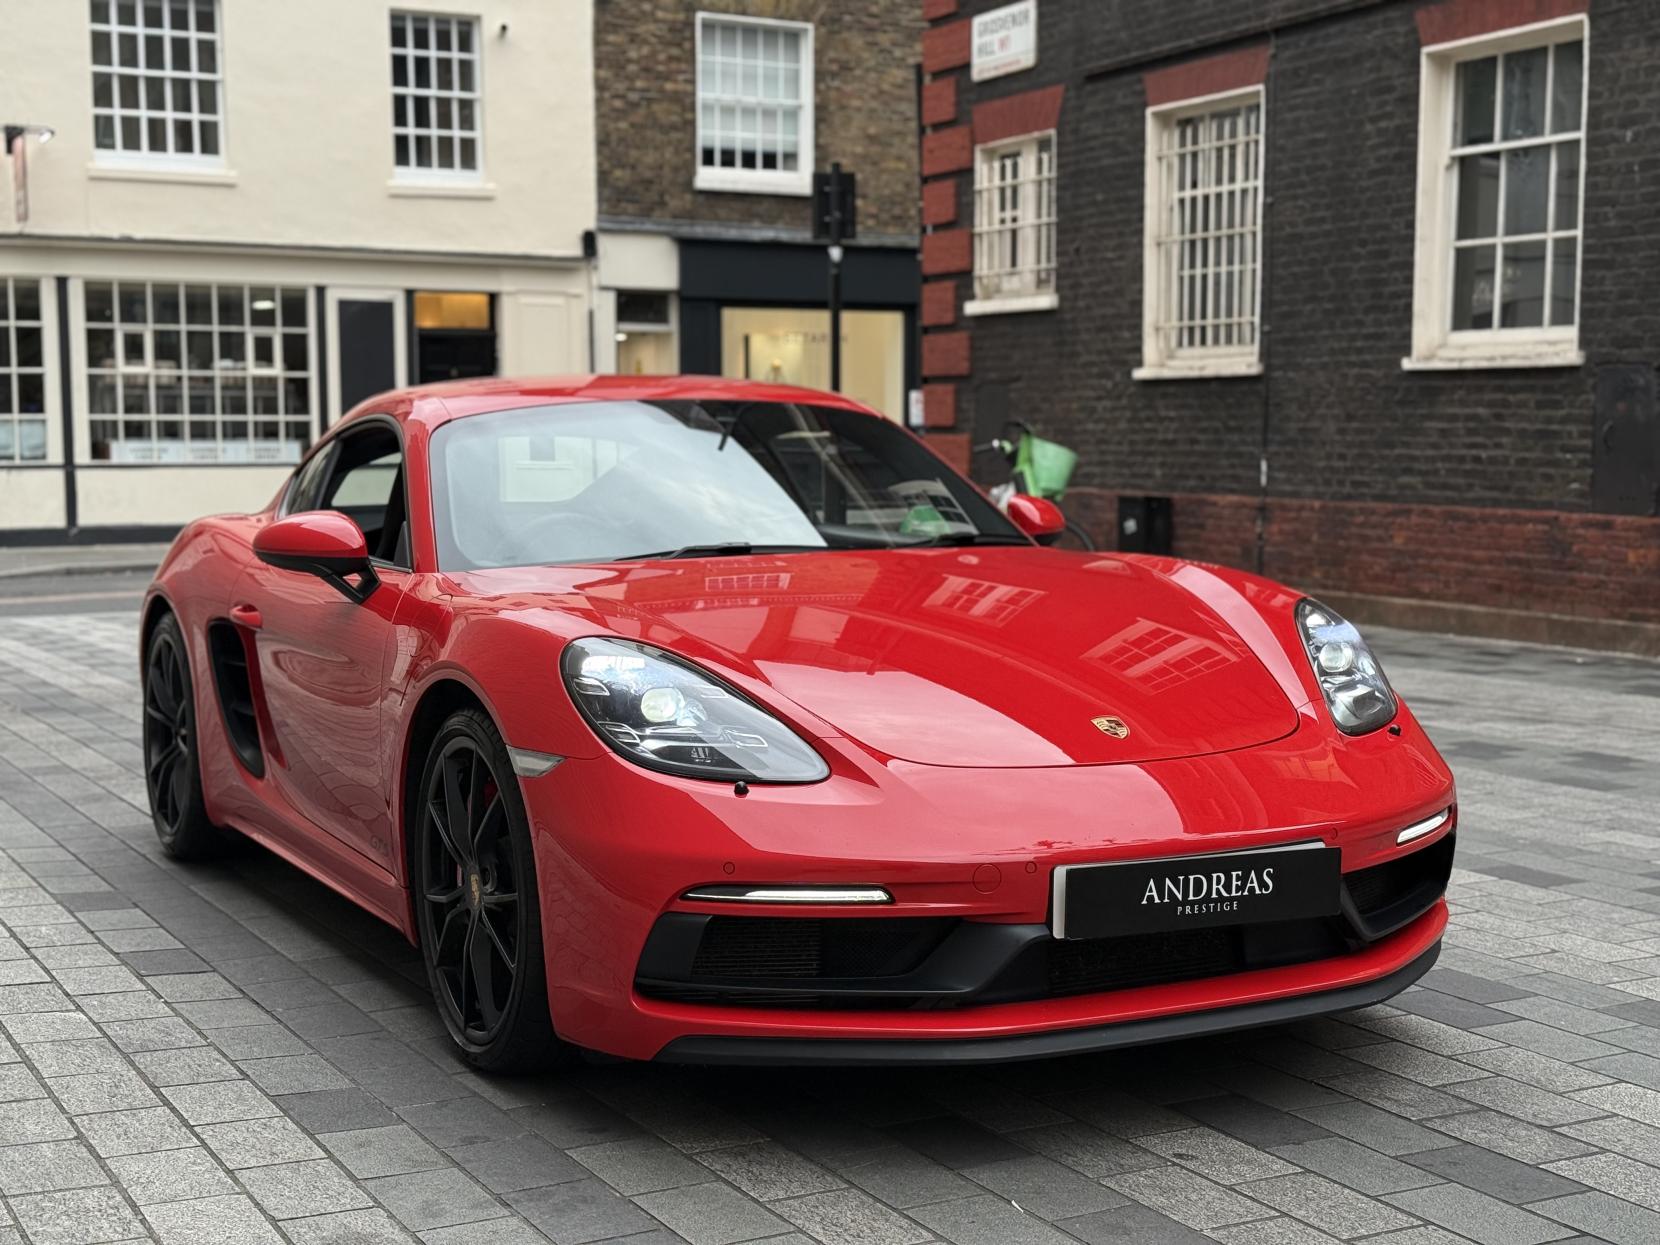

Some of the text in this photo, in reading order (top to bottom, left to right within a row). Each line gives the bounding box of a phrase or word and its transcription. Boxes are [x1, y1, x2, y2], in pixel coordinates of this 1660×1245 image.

[977, 40, 996, 58] HILL
[1141, 868, 1273, 904] ANDREAS
[1177, 901, 1238, 915] PRESTIGE
